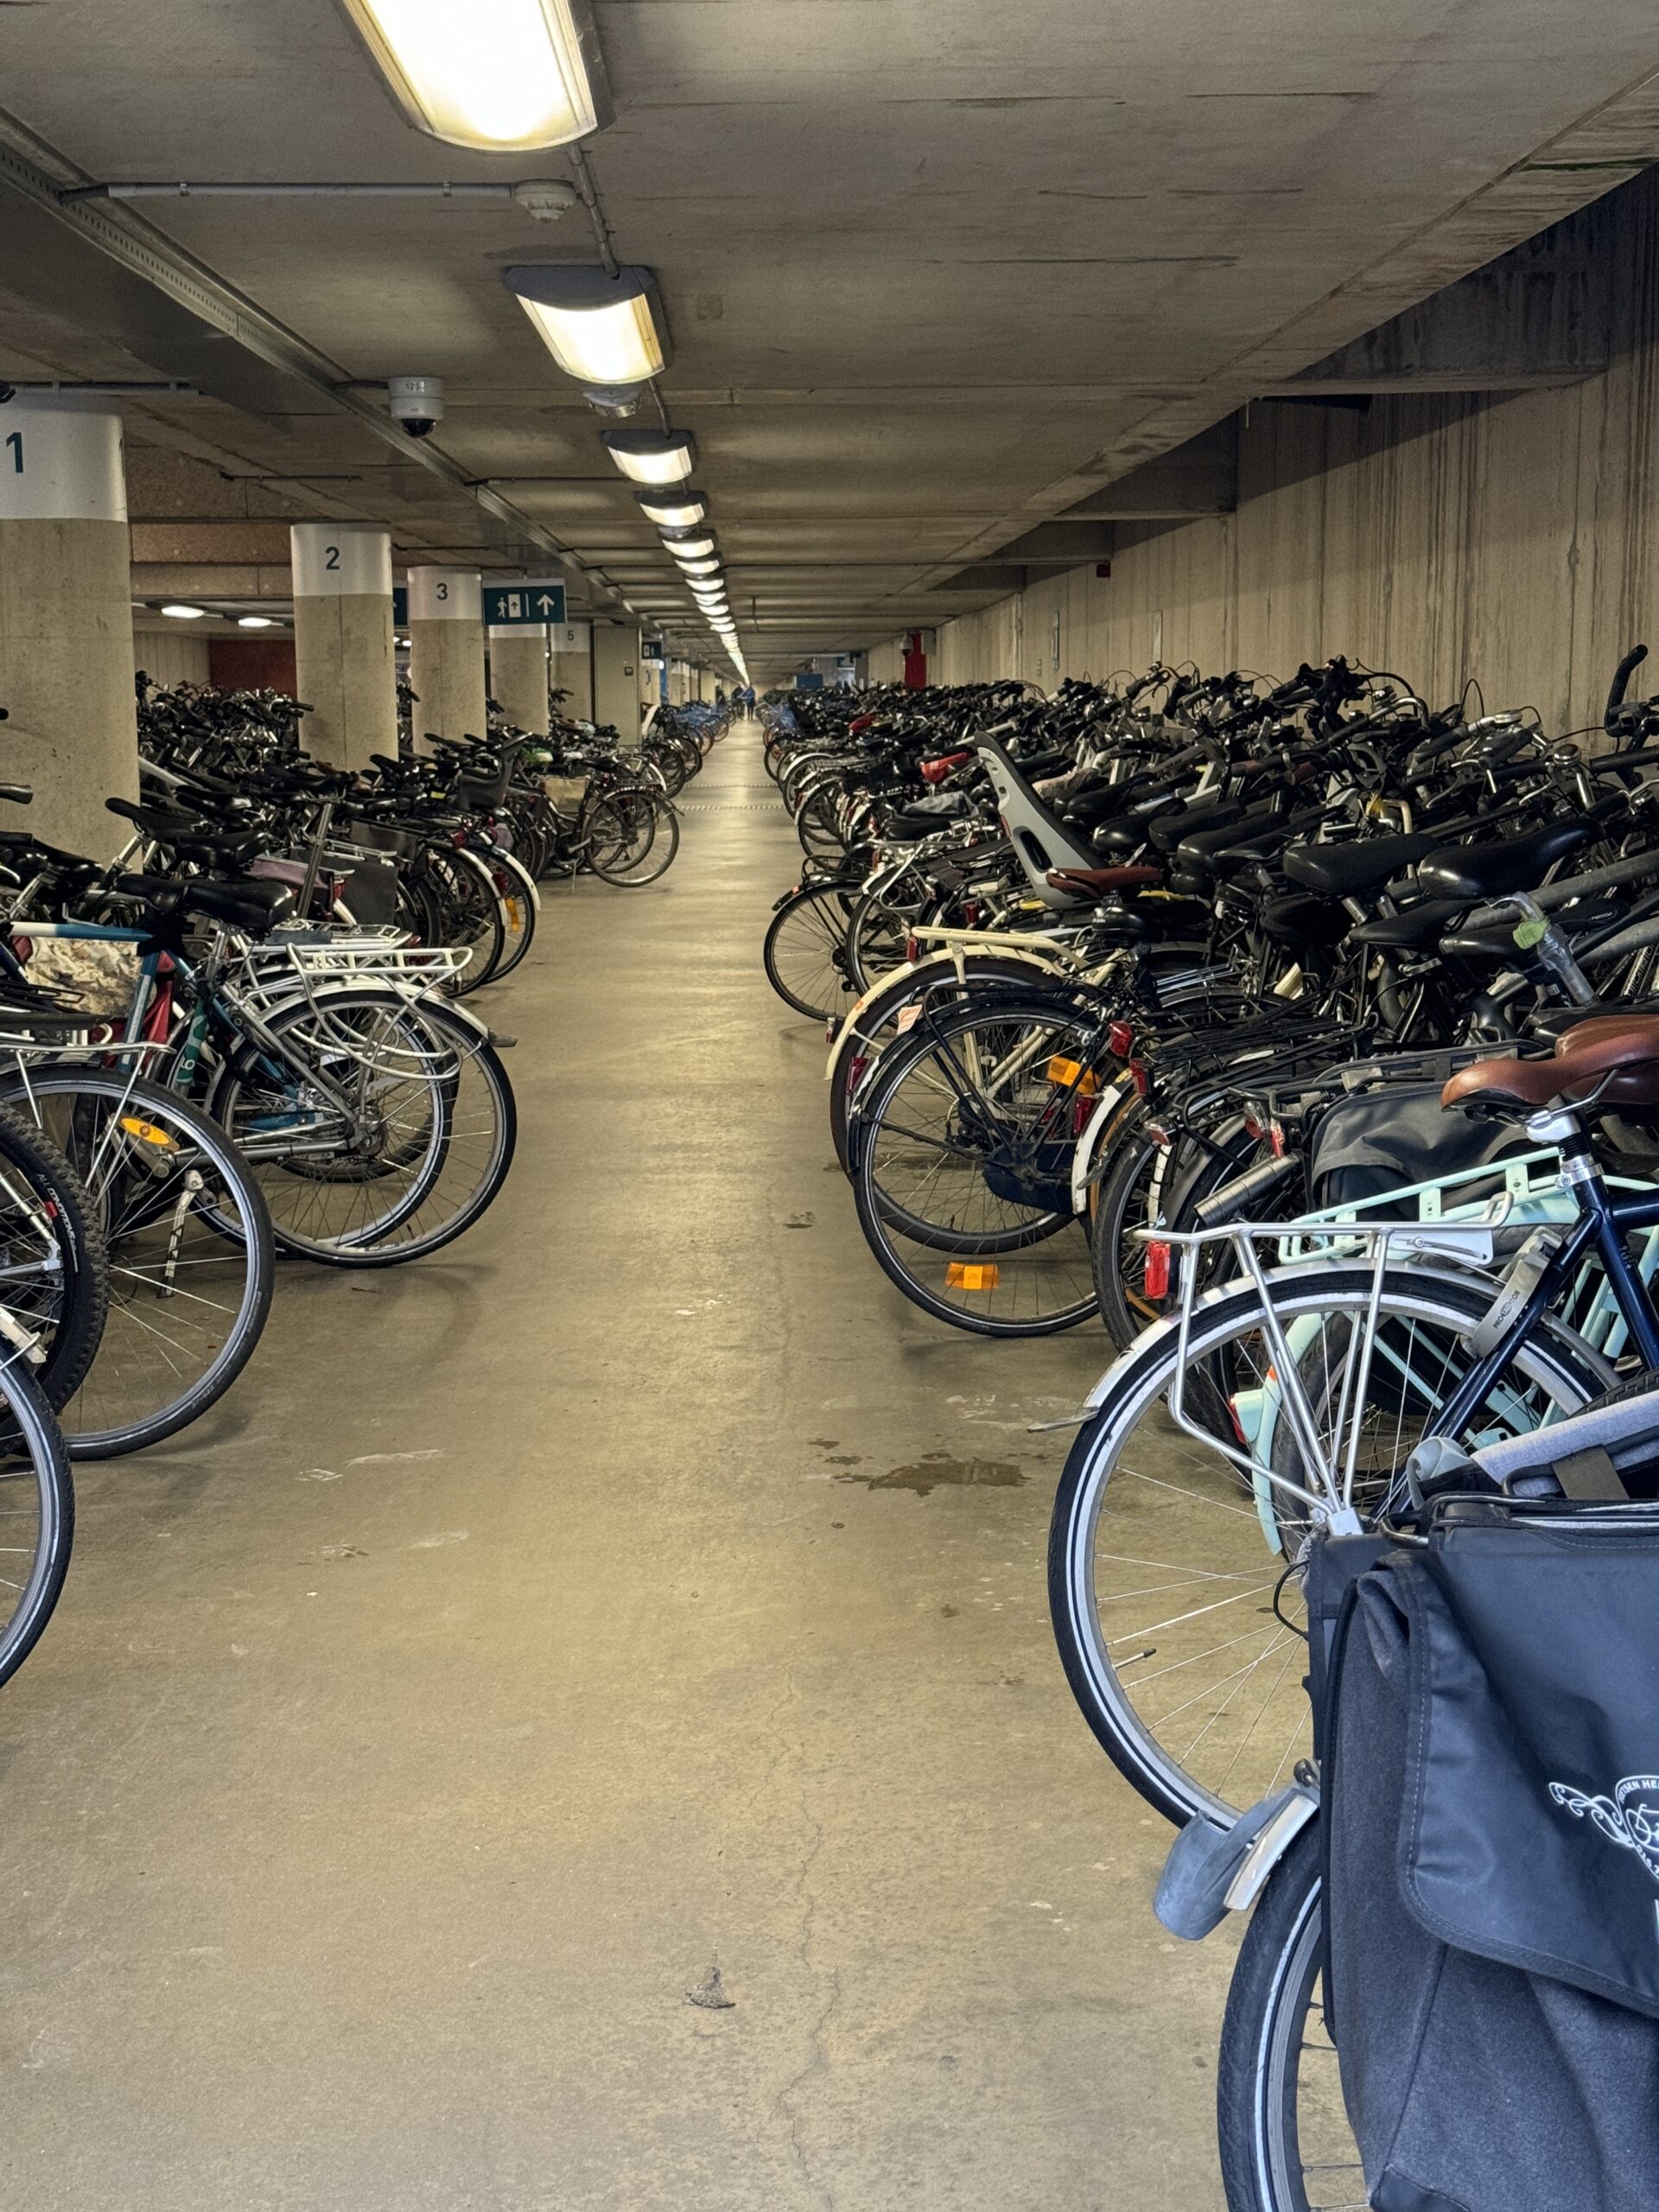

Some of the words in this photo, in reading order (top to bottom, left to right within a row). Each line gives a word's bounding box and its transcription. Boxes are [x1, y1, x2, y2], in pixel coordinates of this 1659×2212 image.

[6, 432, 24, 474] 1
[326, 546, 340, 570] 2
[436, 582, 448, 601] 3
[567, 630, 575, 641] 5
[37, 1173, 51, 1188] ALL
[48, 1187, 76, 1241] CONDITIONS
